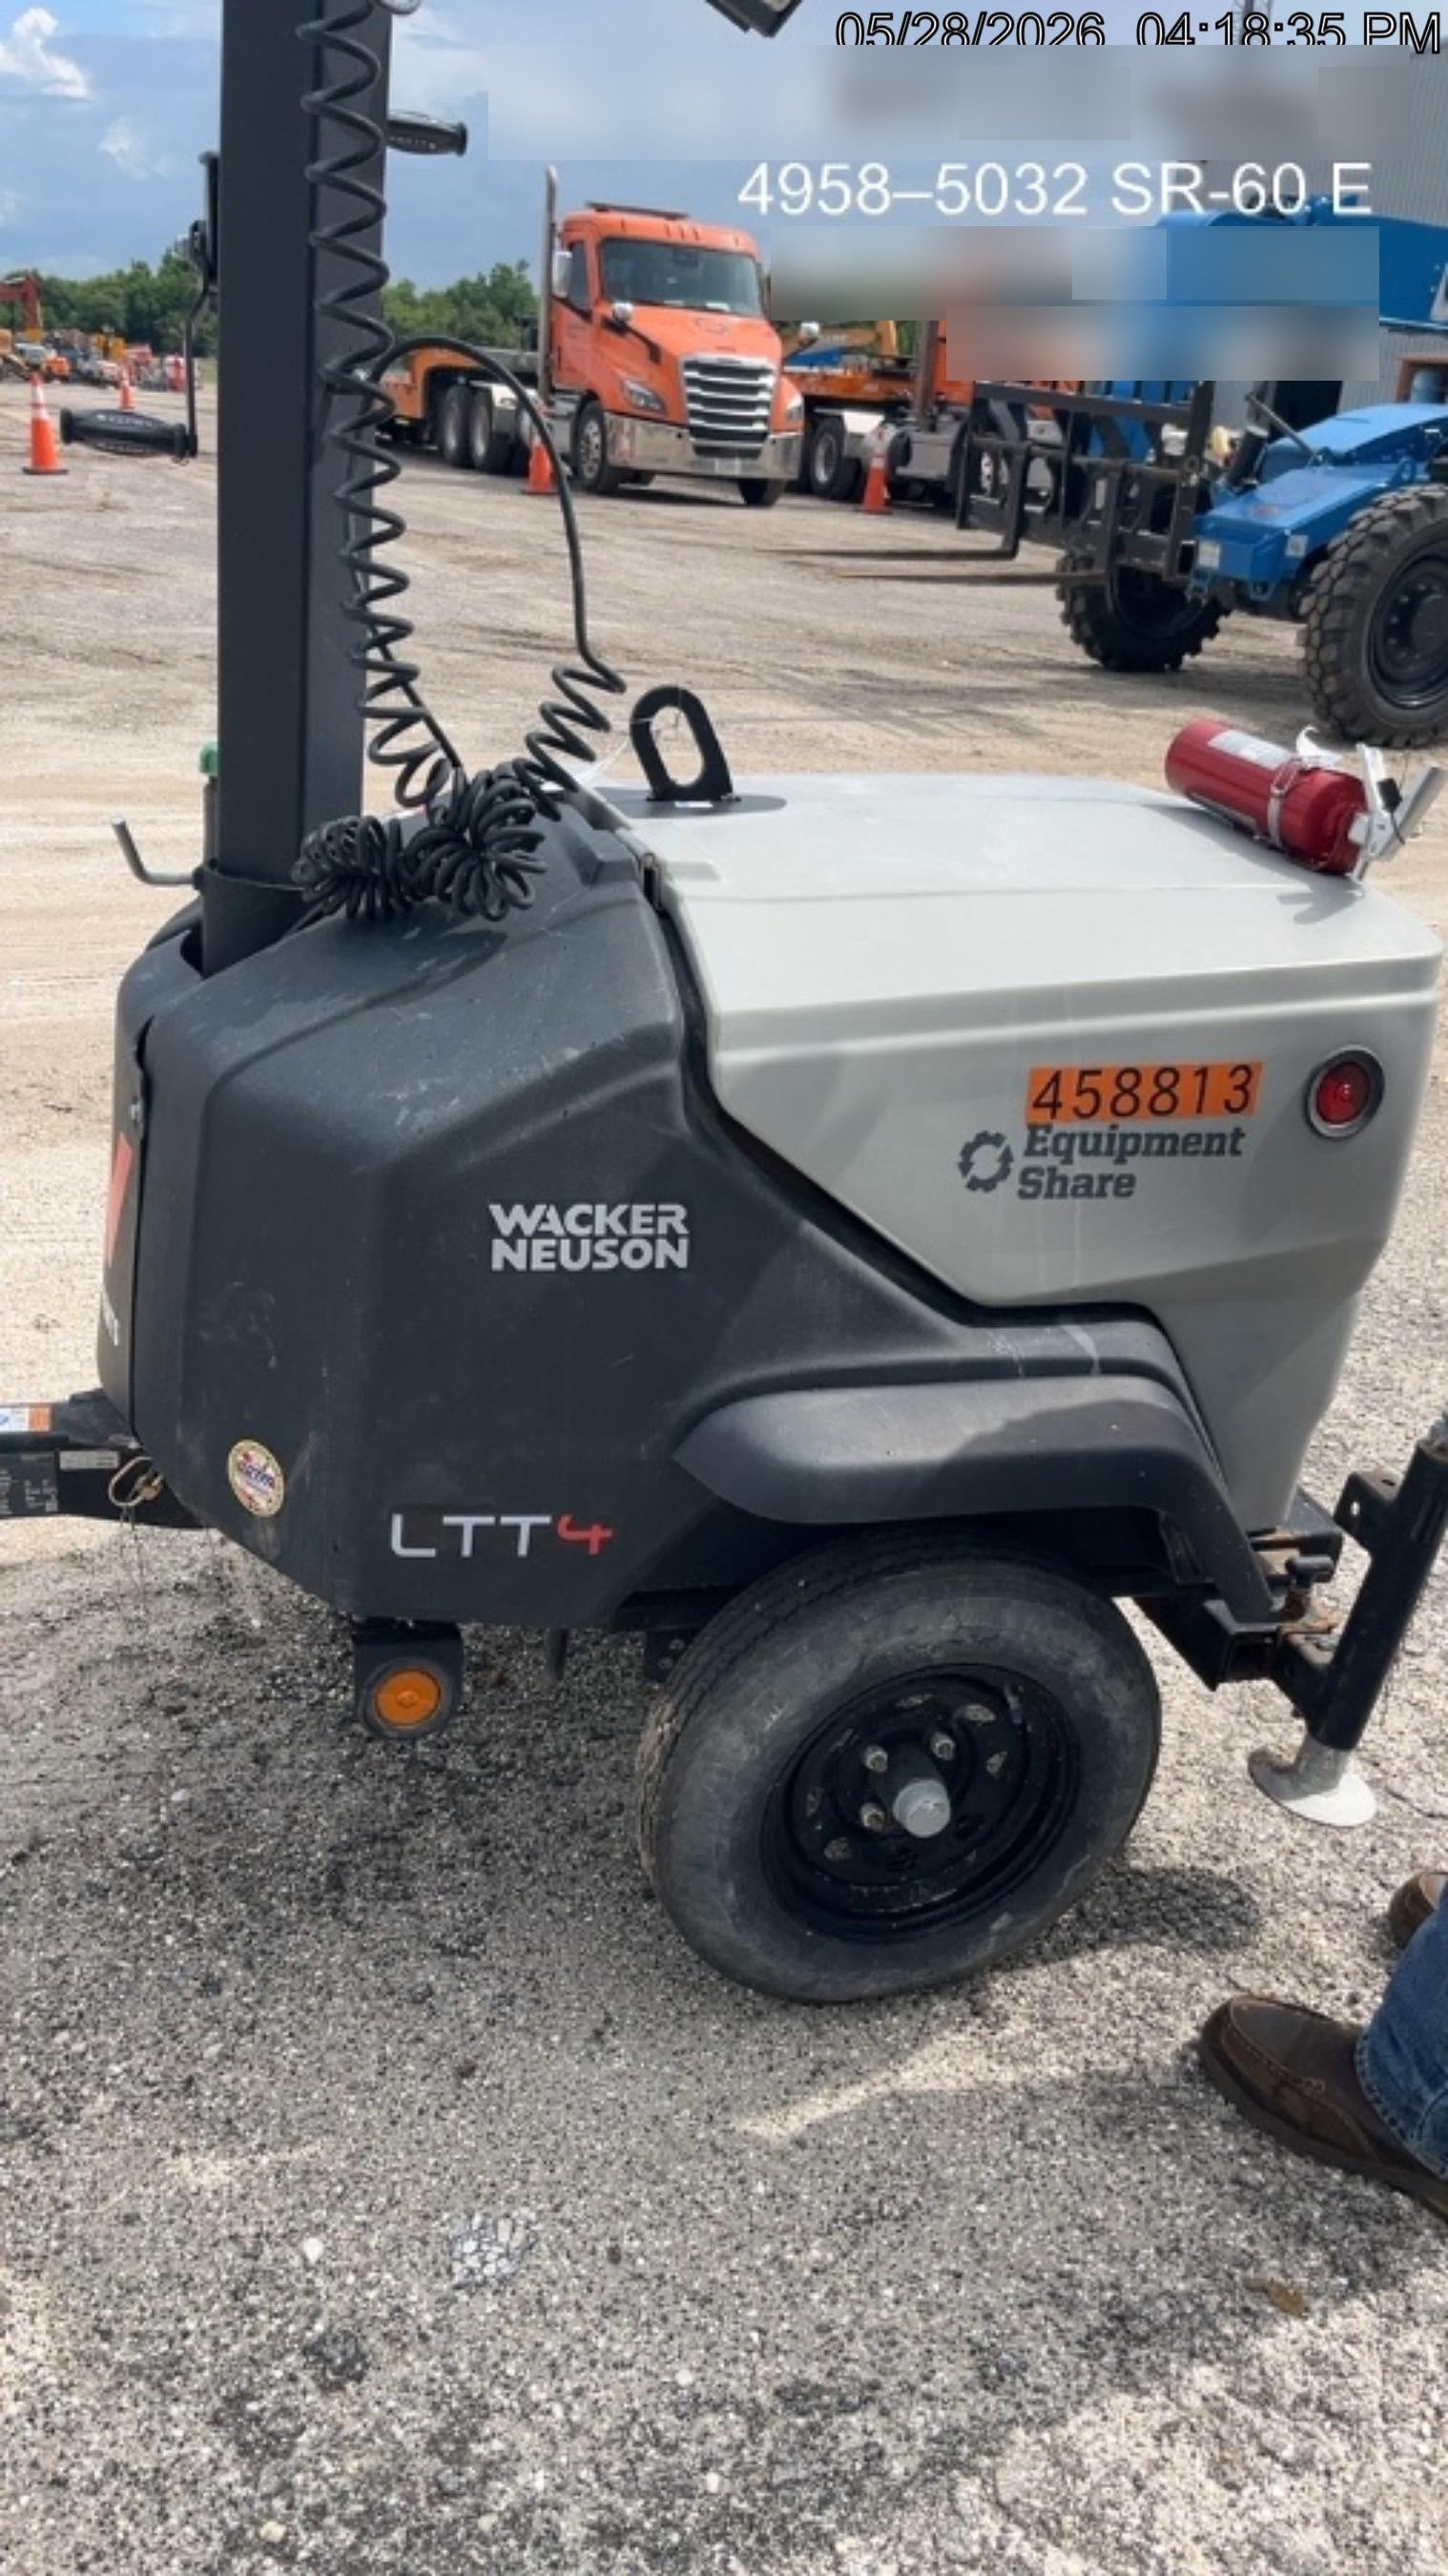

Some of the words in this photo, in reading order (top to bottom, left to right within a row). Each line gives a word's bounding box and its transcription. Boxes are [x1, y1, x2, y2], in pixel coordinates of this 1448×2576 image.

[1031, 1064, 1253, 1120] 458813
[1023, 1123, 1246, 1165] Equipment
[1018, 1166, 1137, 1200] Share
[488, 1203, 690, 1237] WACKER
[490, 1237, 690, 1272] NEUSON
[390, 1513, 613, 1558] LTT4
